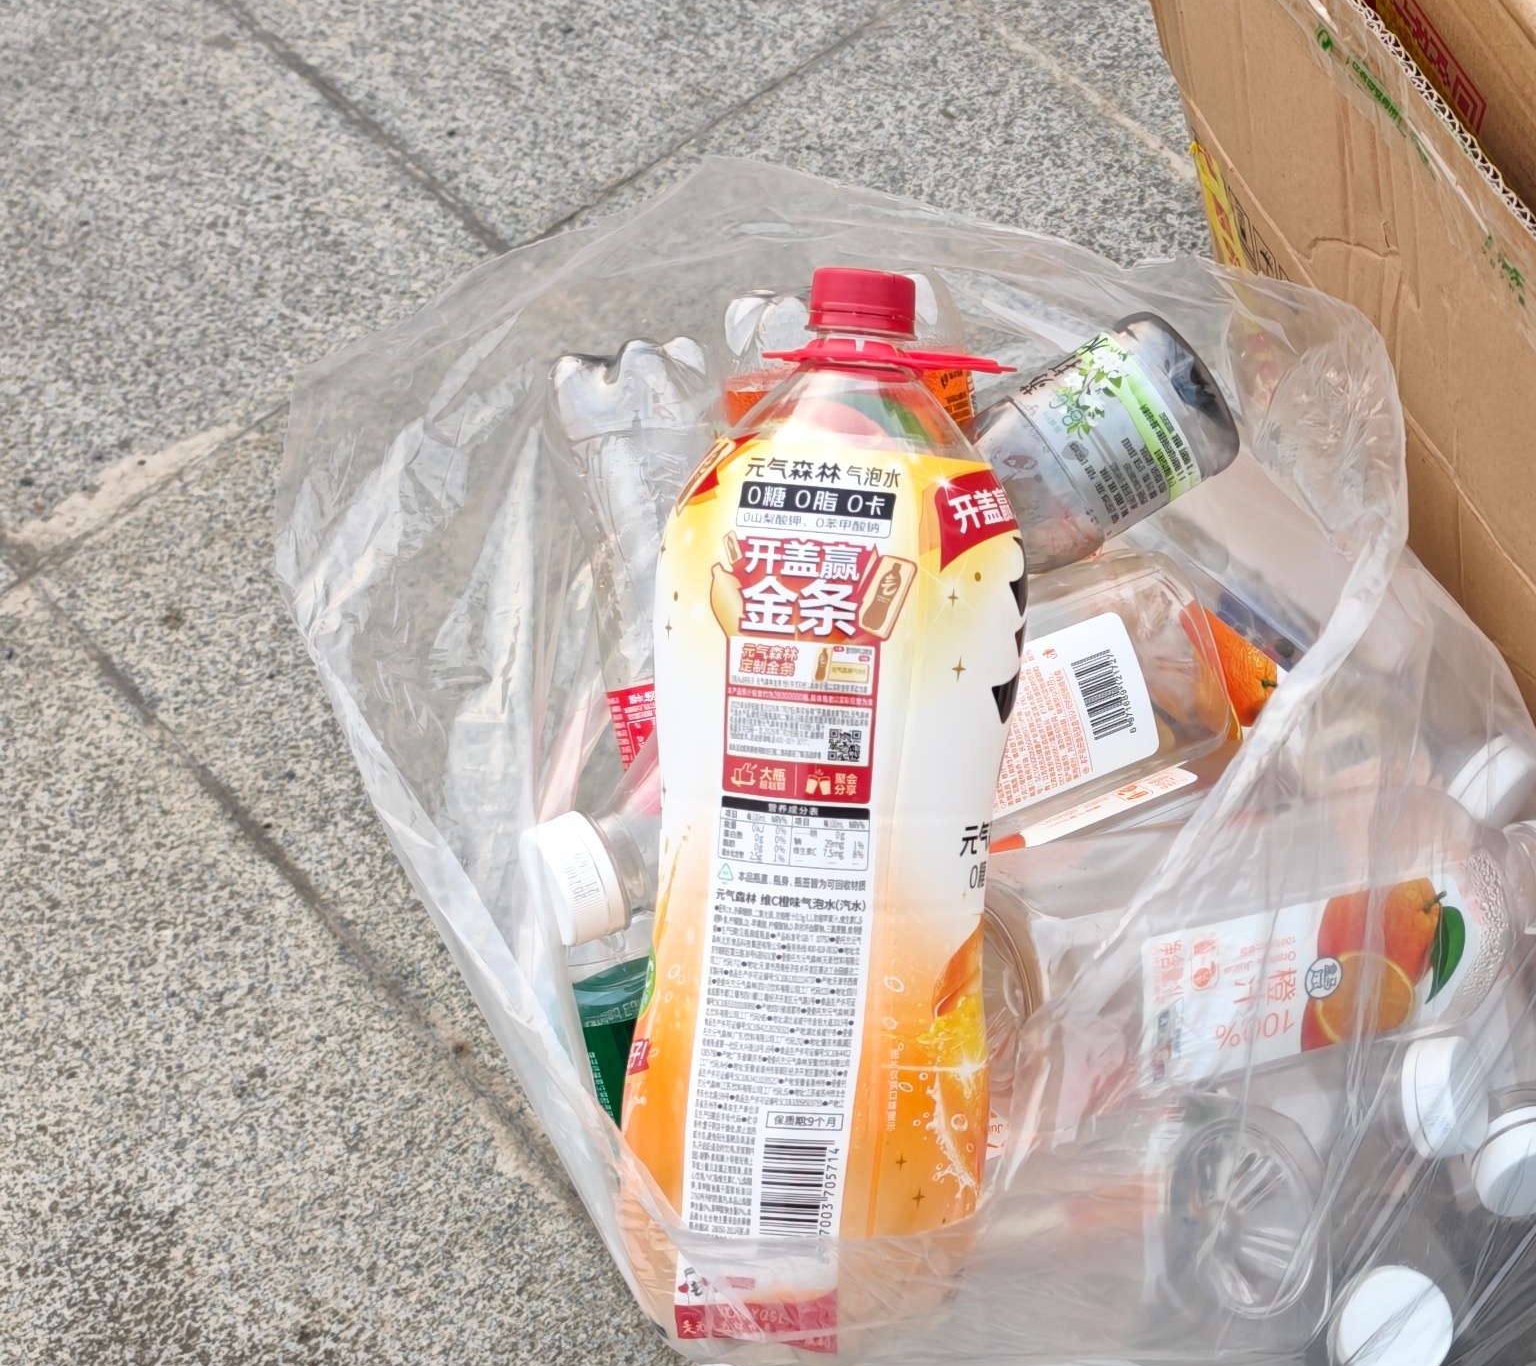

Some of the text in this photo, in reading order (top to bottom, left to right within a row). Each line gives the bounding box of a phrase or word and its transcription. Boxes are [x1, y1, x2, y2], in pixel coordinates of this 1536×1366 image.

[745, 457, 901, 488] 元气森林 气泡水
[747, 485, 885, 516] 0糖 0脂 0卡
[745, 539, 862, 581] 开盖赢
[741, 576, 858, 636] 金条
[742, 642, 799, 662] 元气森林
[739, 659, 796, 677] 定制金条
[760, 767, 786, 782] 大瓶
[835, 784, 857, 796] 分享
[768, 803, 819, 816] 营养成分表
[775, 826, 787, 835] 0%
[835, 831, 845, 841] 0g
[775, 836, 786, 844] 0%
[774, 845, 785, 853] 0%
[716, 888, 756, 904] 元气森林
[1215, 1009, 1294, 1050] 100%
[823, 1147, 840, 1197] 705714
